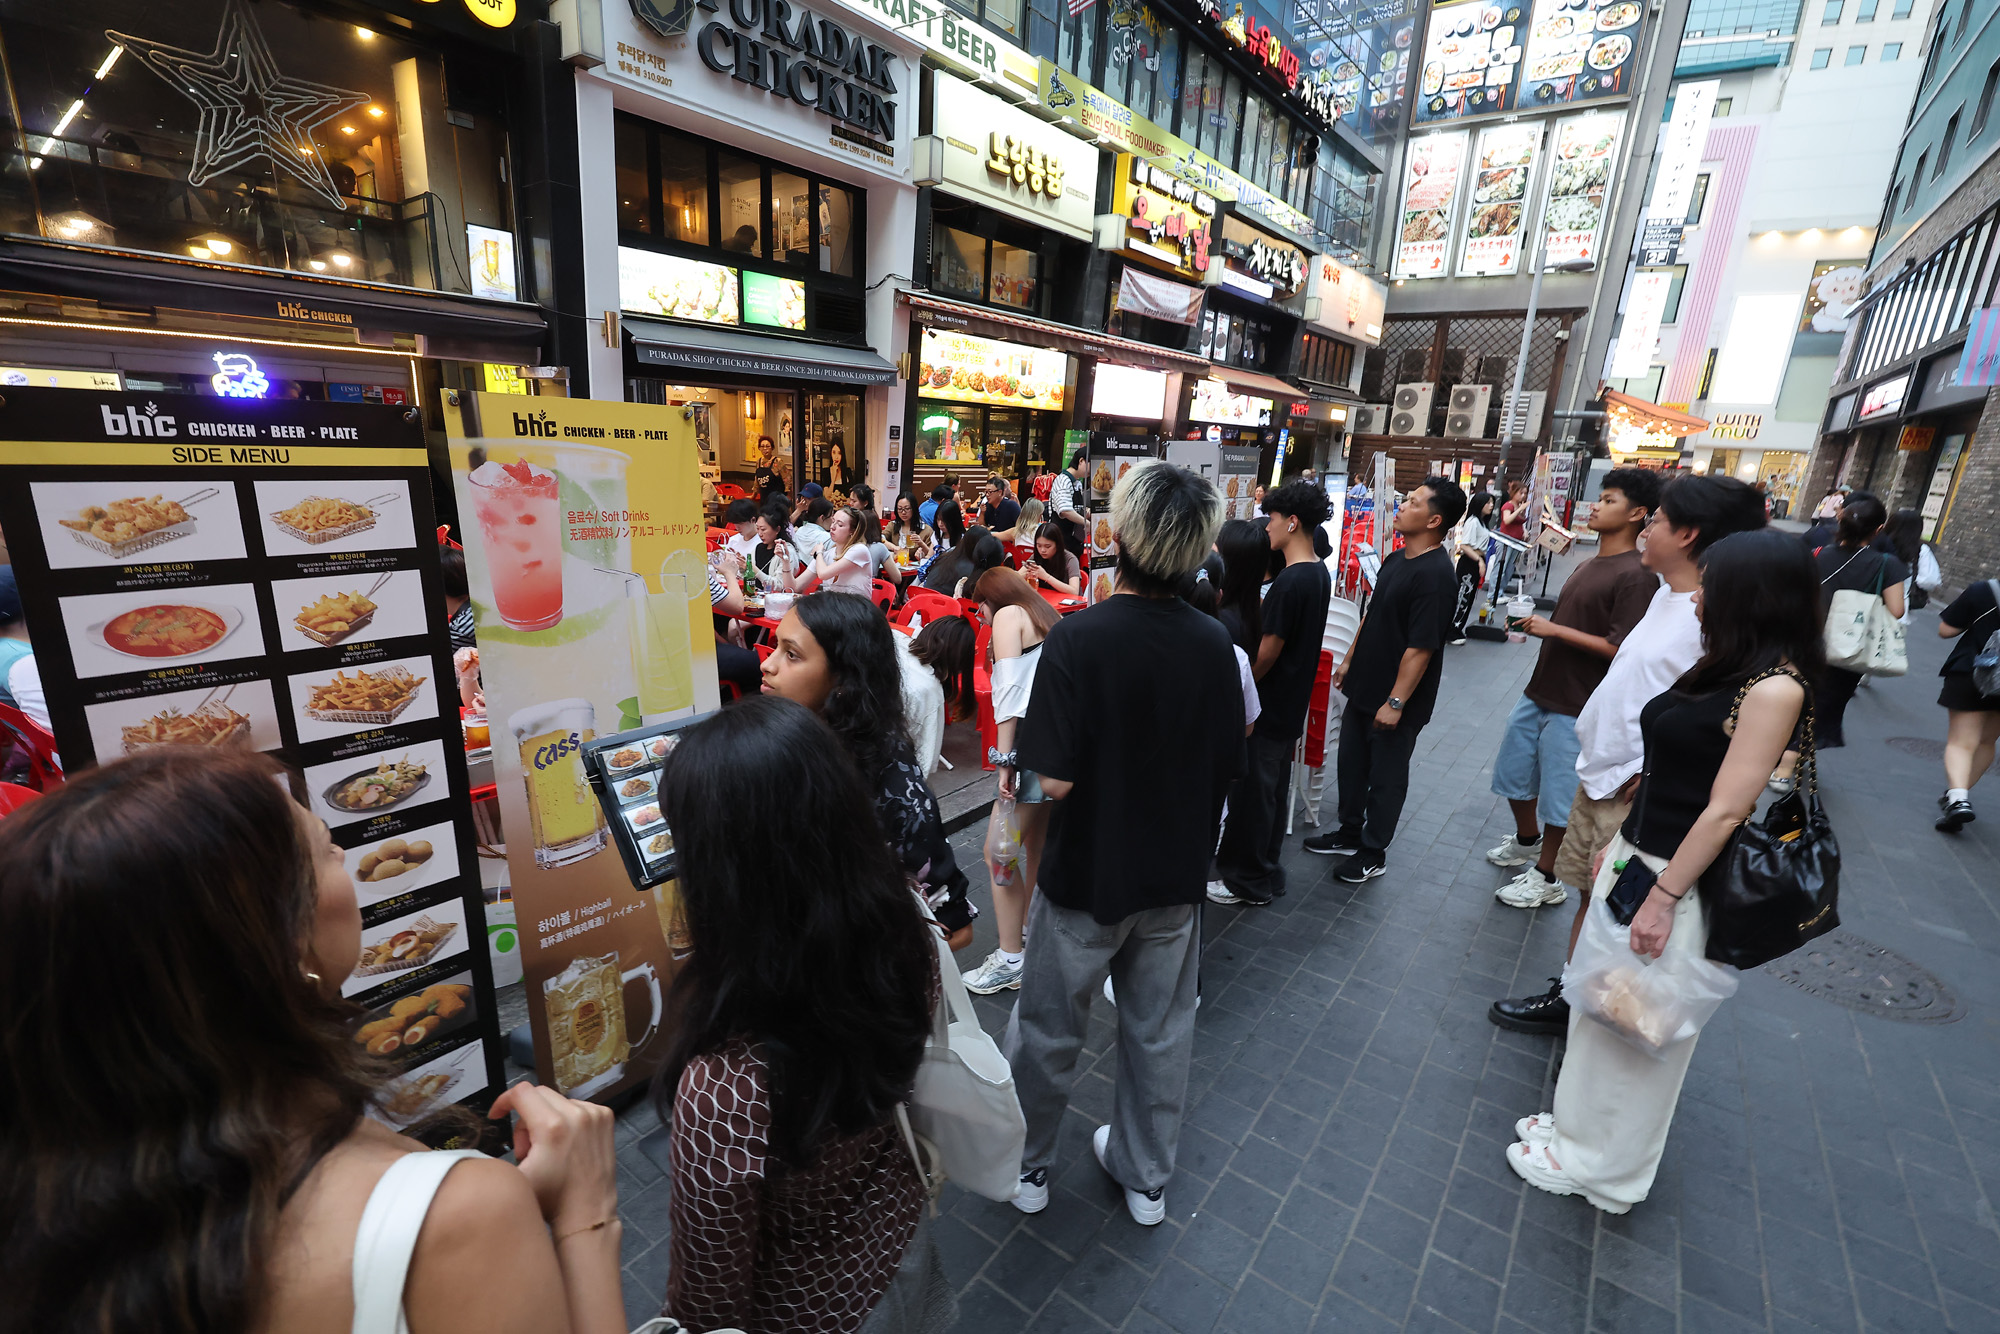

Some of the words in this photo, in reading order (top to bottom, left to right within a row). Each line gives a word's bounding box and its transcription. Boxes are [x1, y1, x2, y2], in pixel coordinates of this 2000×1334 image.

[697, 0, 898, 94] URADAK
[864, 0, 937, 38] RAFT
[942, 16, 997, 73] BEER
[617, 41, 646, 66] 푸라닭
[646, 48, 667, 73] 치킨
[1244, 15, 1300, 91] 뉴욕야시장
[697, 22, 898, 141] CHICKEN
[1082, 89, 1111, 116] 뉴욕에서
[1112, 104, 1132, 126] 달러온
[1081, 108, 1103, 131] 당신의
[1104, 119, 1124, 140] SOUL
[1125, 129, 1143, 148] FOOD
[985, 131, 1065, 199] 노랑통닭
[1647, 251, 1668, 264] 2F
[277, 301, 309, 319] bhc
[311, 310, 353, 324] CHICKEN
[649, 350, 691, 363] PURADAK
[692, 354, 715, 364] SHOP
[716, 357, 752, 369] CHICKEN
[753, 361, 760, 369] &
[761, 362, 781, 372] BEER
[784, 365, 806, 374] SINCE
[806, 366, 820, 376] 2014
[824, 369, 855, 379] PURADAK
[855, 371, 876, 381] LOVES
[386, 392, 403, 400] 에스원
[101, 402, 178, 437] bhc
[188, 422, 257, 438] CHICKEN
[271, 425, 306, 439] BEER
[320, 426, 359, 440] PLATE
[513, 411, 558, 437] bhc
[563, 426, 606, 438] CHICKEN
[614, 428, 636, 439] BEER
[644, 430, 669, 441] PLATE
[1716, 413, 1762, 427] WITH
[172, 446, 223, 463] SIDE
[230, 447, 290, 464] MENU
[1106, 437, 1118, 449] bhc
[601, 510, 620, 523] Soft
[622, 510, 650, 522] Drinks
[537, 910, 571, 933] 하이볼
[580, 897, 612, 917] Highball
